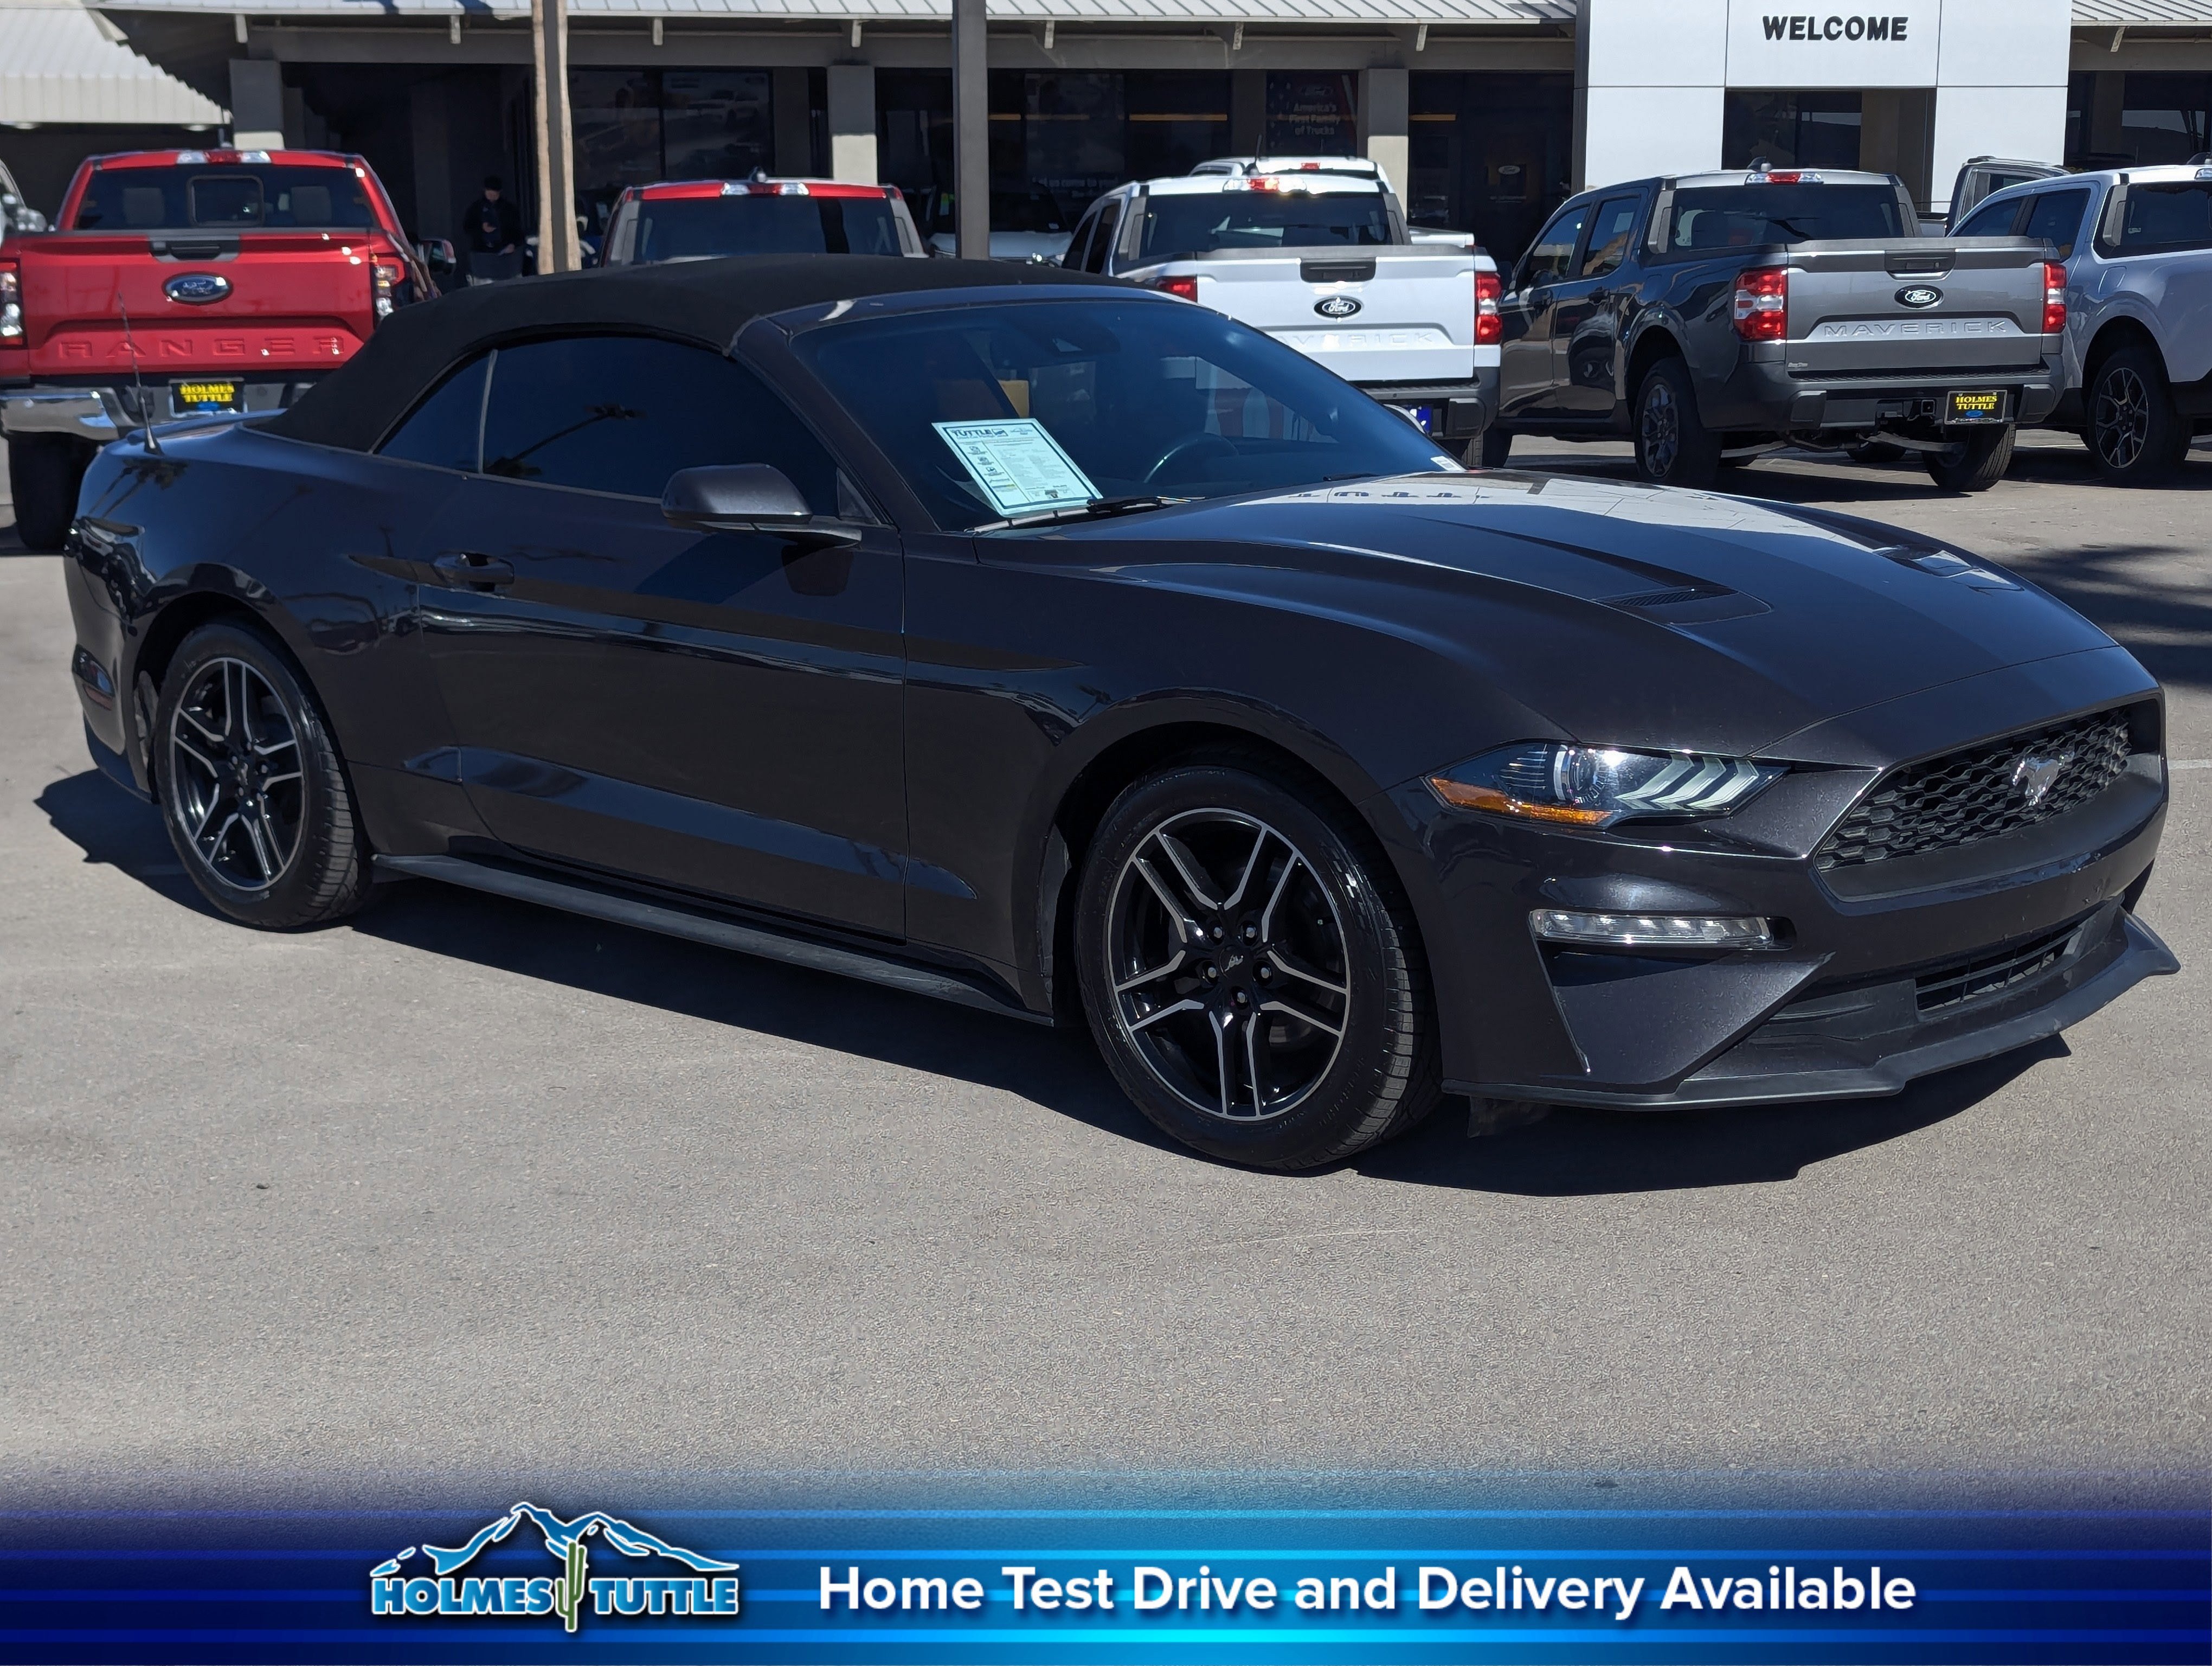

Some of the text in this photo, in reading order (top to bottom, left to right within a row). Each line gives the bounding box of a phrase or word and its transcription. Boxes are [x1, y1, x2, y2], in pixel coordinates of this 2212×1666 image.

[1763, 16, 1908, 41] WELCOME
[1910, 292, 1931, 302] Ford
[1328, 300, 1349, 312] Ford
[1824, 321, 2007, 337] MAVERICK
[59, 336, 345, 358] RANGER
[179, 383, 234, 395] HOLMES
[182, 393, 233, 402] TUTTLE
